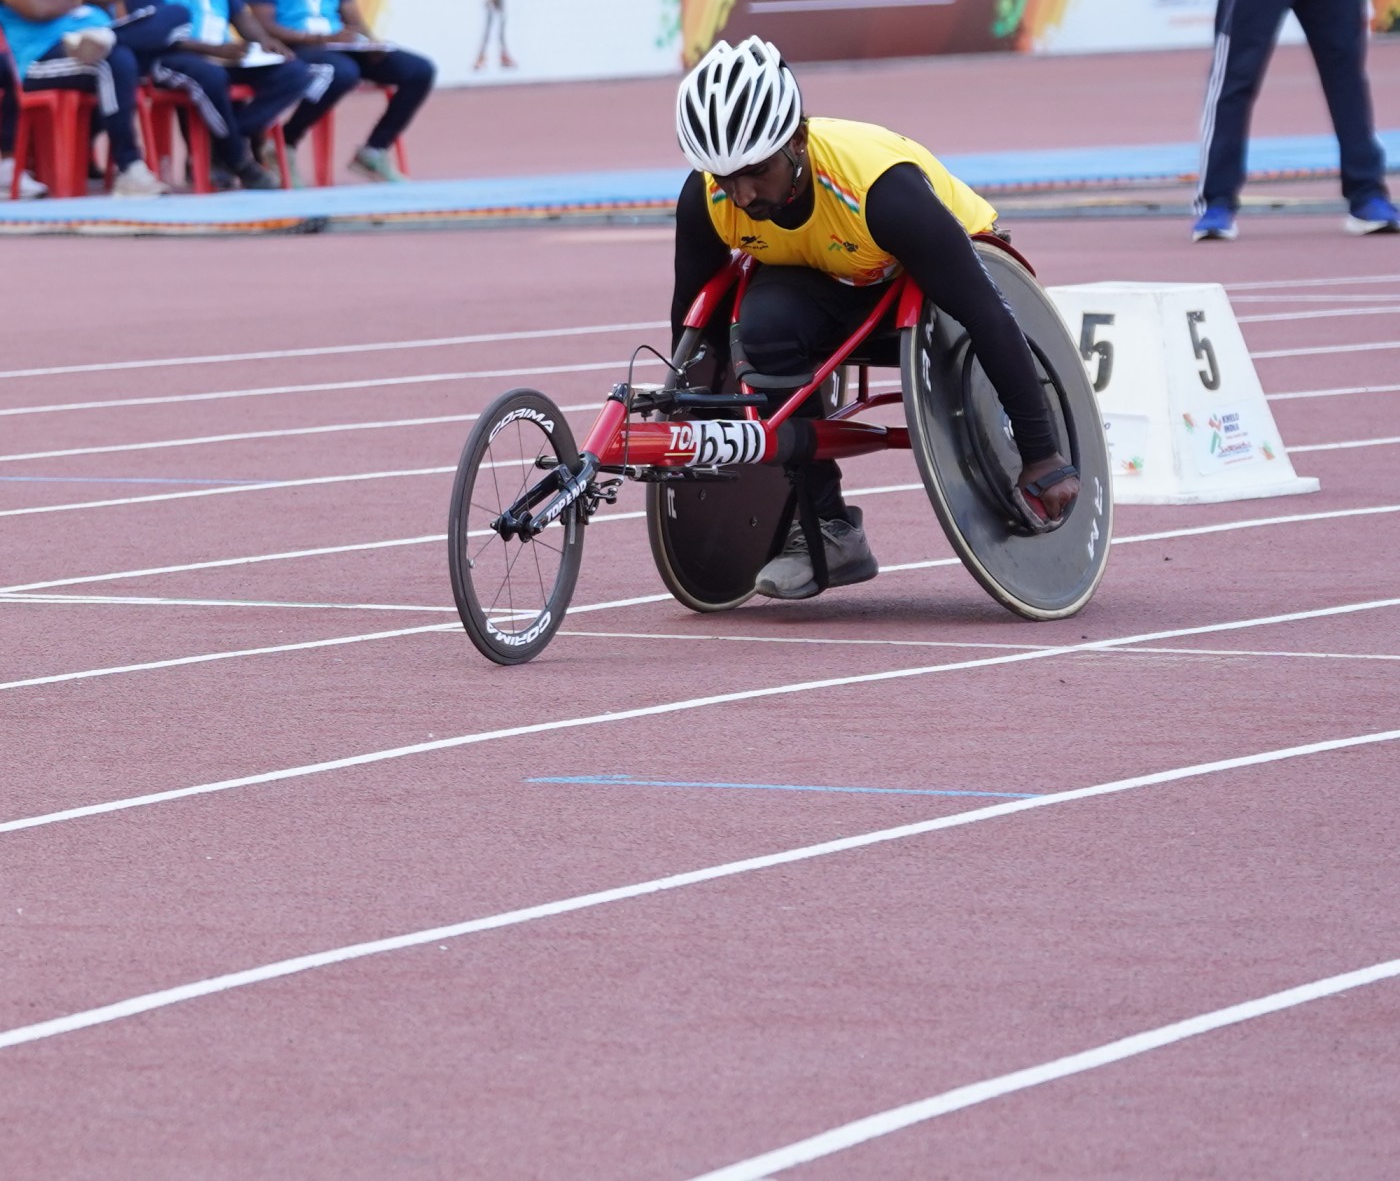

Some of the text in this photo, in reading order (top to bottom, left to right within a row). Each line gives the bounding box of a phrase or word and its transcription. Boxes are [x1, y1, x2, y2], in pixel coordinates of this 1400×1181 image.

[1080, 312, 1115, 393] 5
[1186, 310, 1221, 391] 5
[488, 407, 555, 443] CORIMA
[1221, 412, 1240, 423] KHELO
[486, 611, 551, 646] CORIMA
